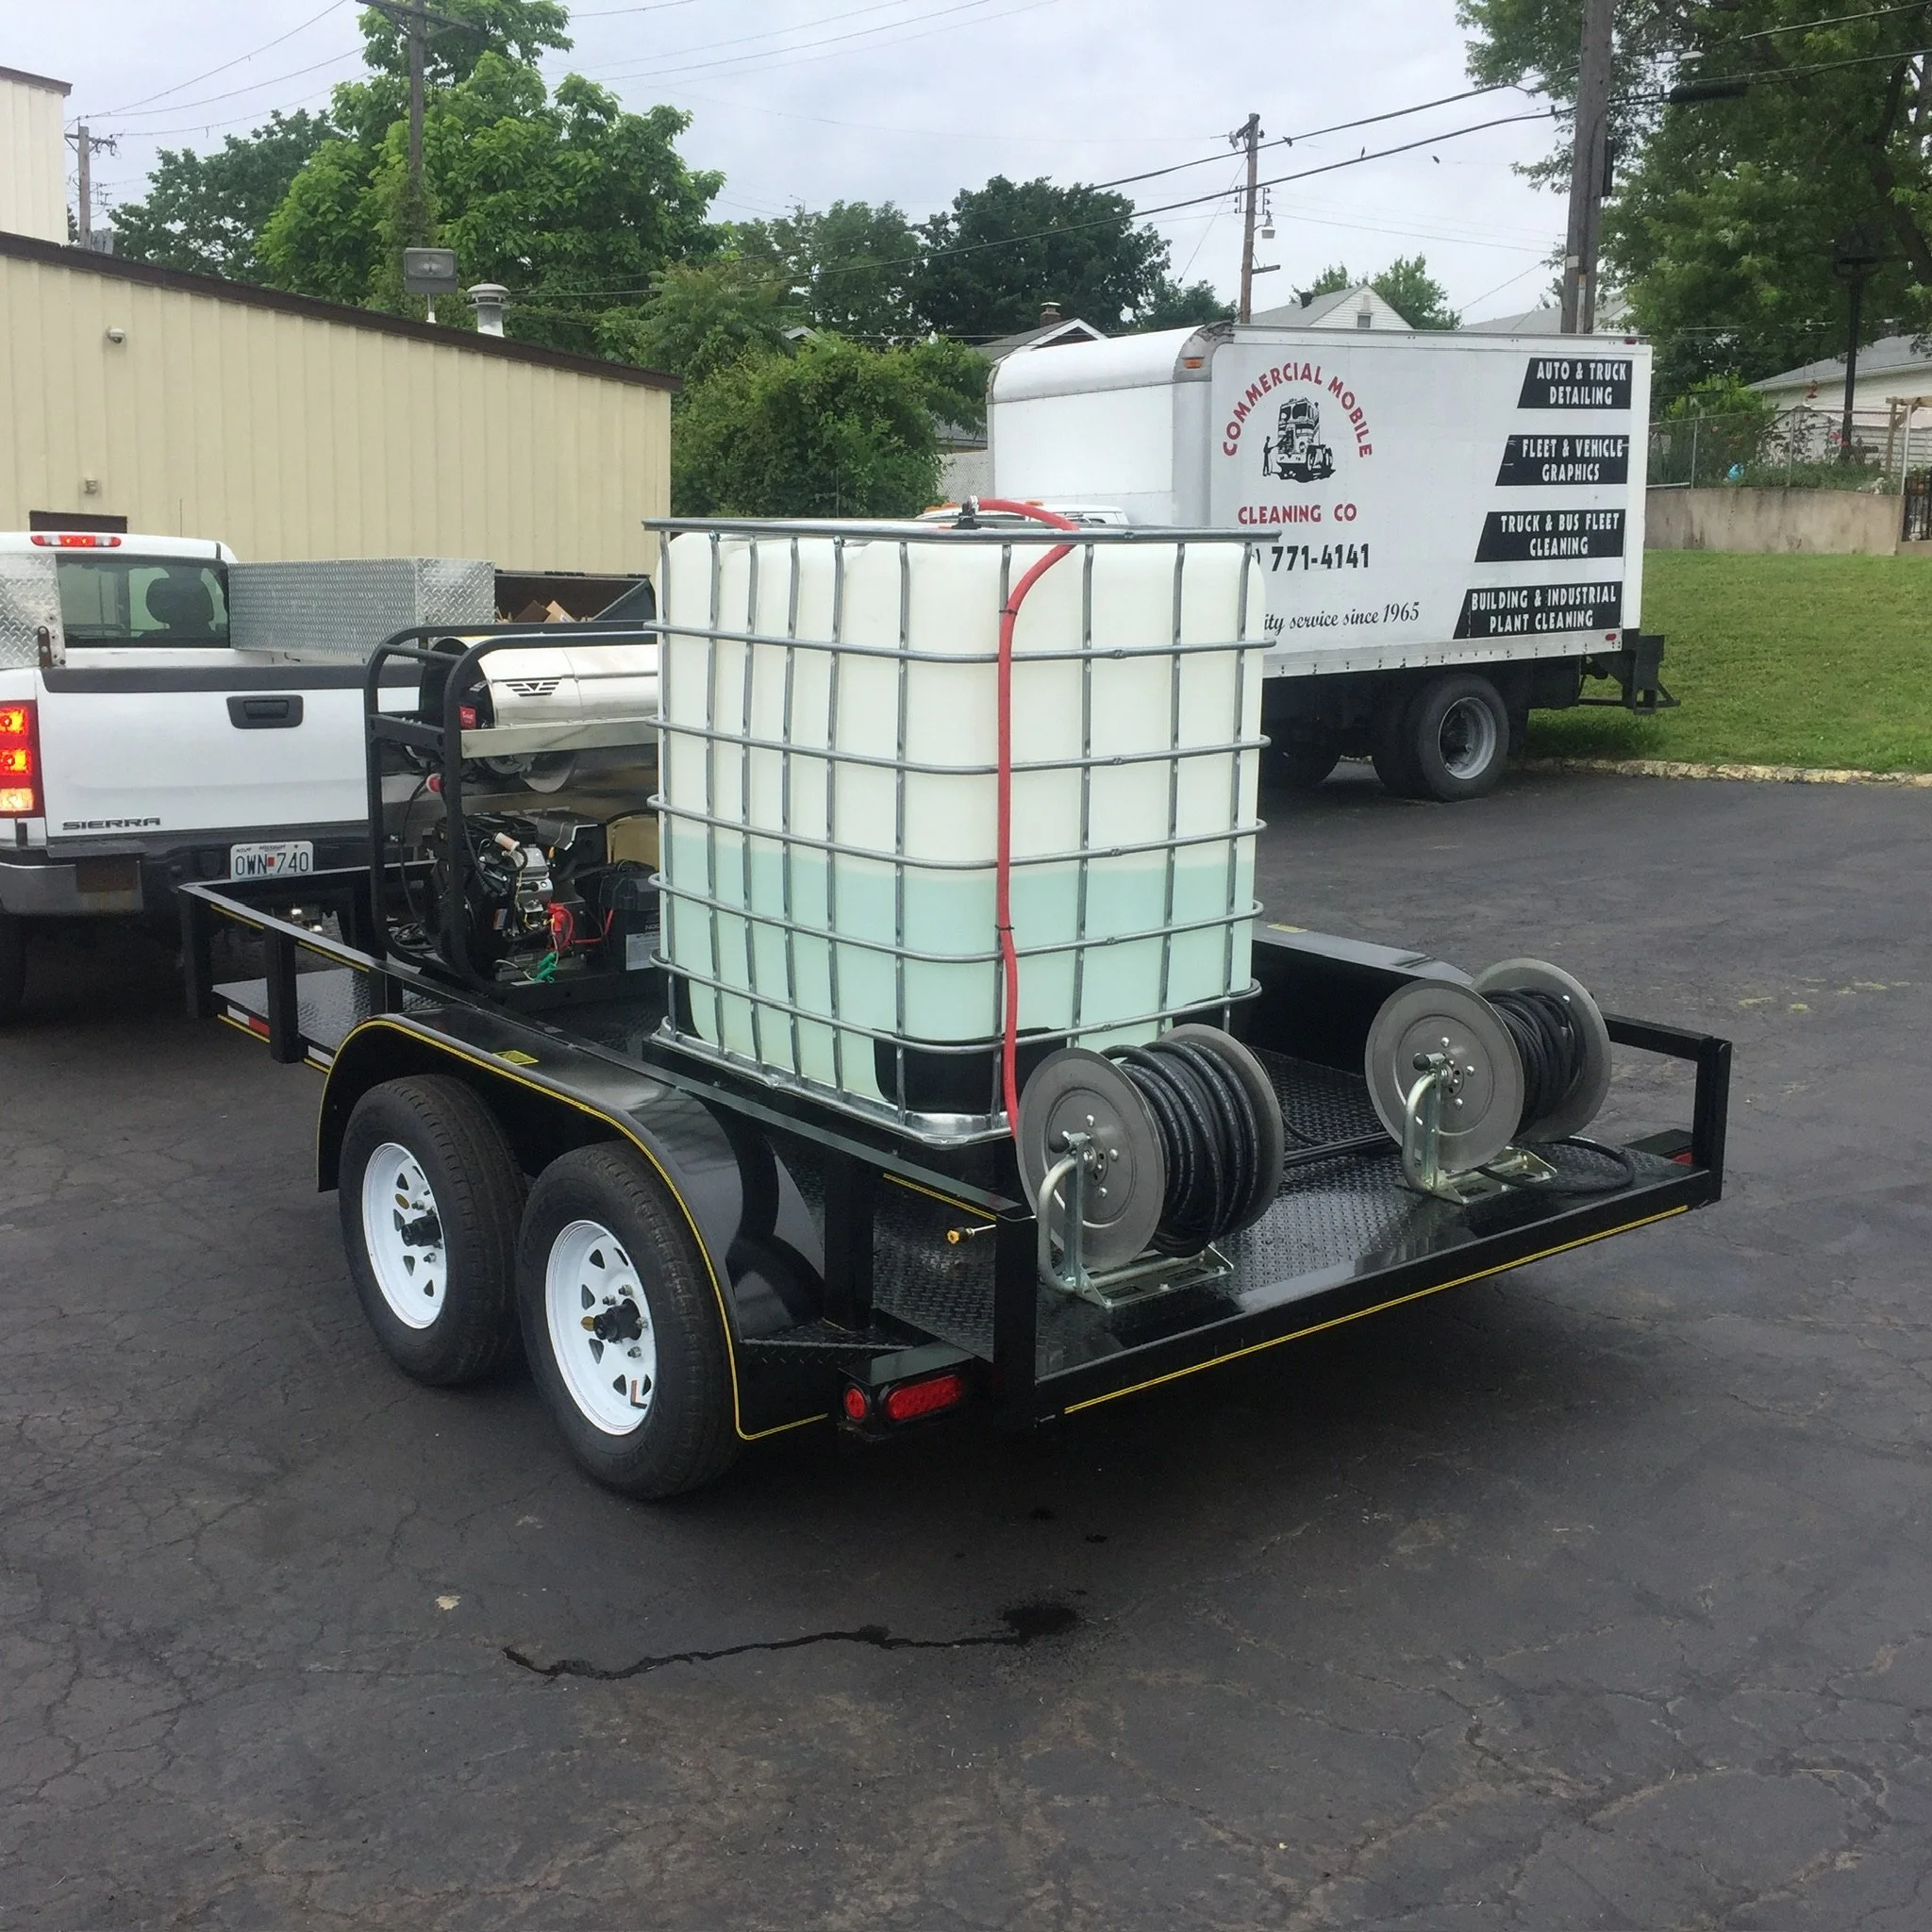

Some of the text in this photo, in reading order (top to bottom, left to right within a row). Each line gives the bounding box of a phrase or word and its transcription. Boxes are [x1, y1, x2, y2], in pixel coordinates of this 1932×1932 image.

[1537, 361, 1627, 380] AUTO & TRUCK
[1549, 386, 1613, 405] DETAILING
[1223, 362, 1373, 458] COMMERCIAL MOBILE
[1523, 439, 1624, 458] FLEET & VEHICLE
[1541, 463, 1600, 482] GRAPHICS
[1238, 503, 1357, 525] CLEANING CO
[1501, 512, 1620, 533] TRUCK & BUS FLEET
[1529, 536, 1589, 557] CLEANING
[1271, 543, 1369, 572] 771-4141
[1471, 585, 1616, 611] BUILDING & INDUSTRIAL
[1289, 609, 1339, 629] service
[1342, 608, 1379, 626] since
[1383, 601, 1420, 624] 1965
[1490, 609, 1593, 633] PLANT CLEANING
[62, 817, 161, 830] SIERRA
[276, 852, 308, 873] 740
